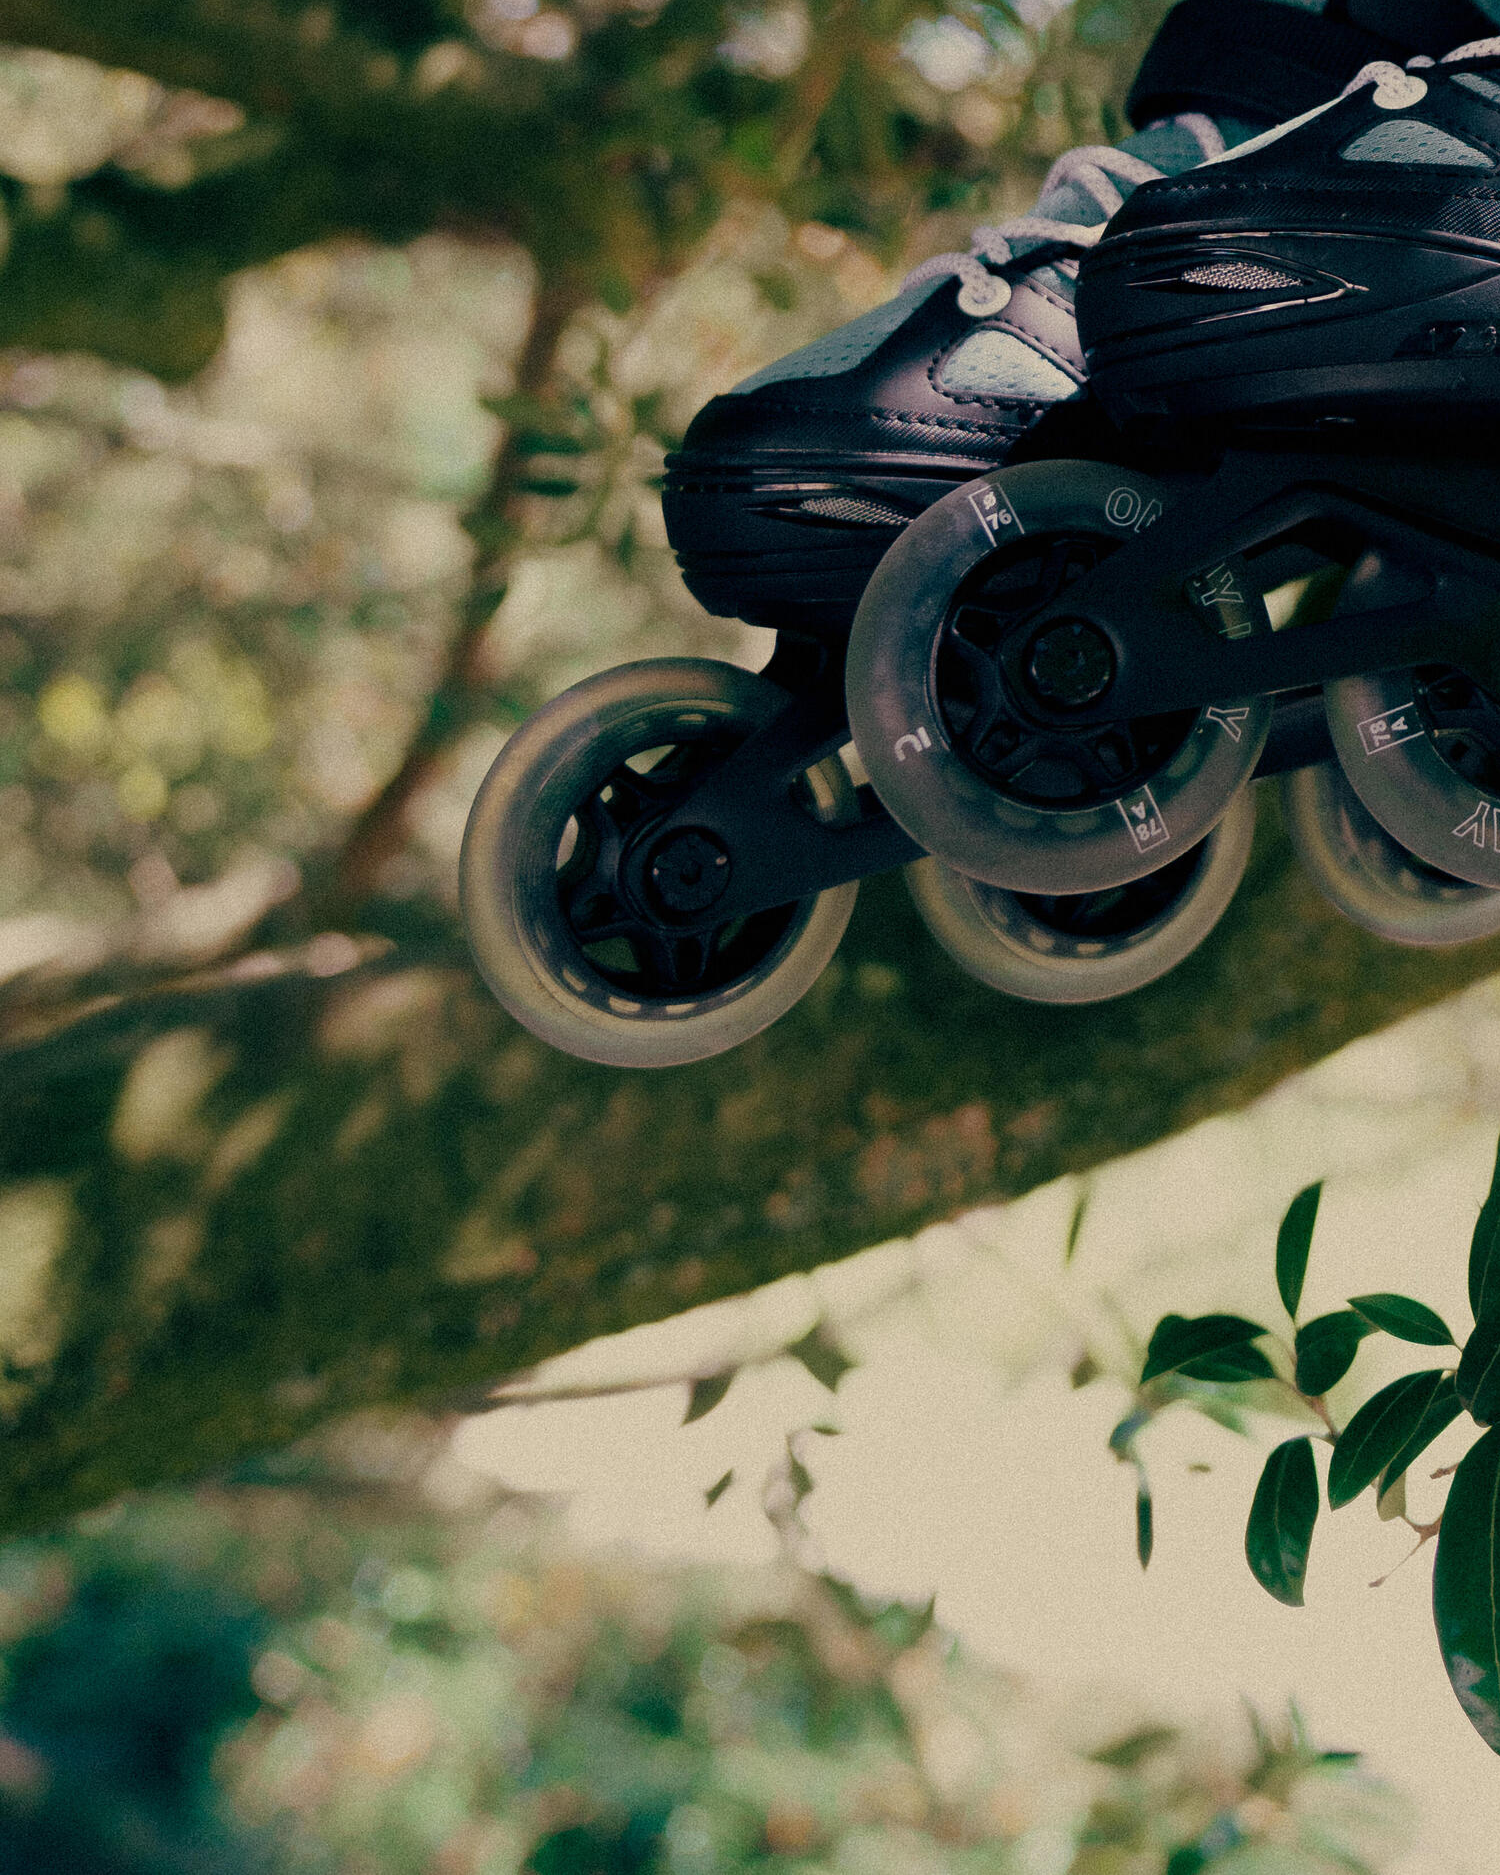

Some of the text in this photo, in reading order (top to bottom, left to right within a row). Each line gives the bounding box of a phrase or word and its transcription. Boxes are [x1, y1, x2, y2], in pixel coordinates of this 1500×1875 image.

[986, 508, 1013, 532] 76
[1369, 719, 1391, 747] 78
[1391, 716, 1409, 731] A
[1130, 801, 1147, 819] A
[1135, 817, 1162, 841] 78
